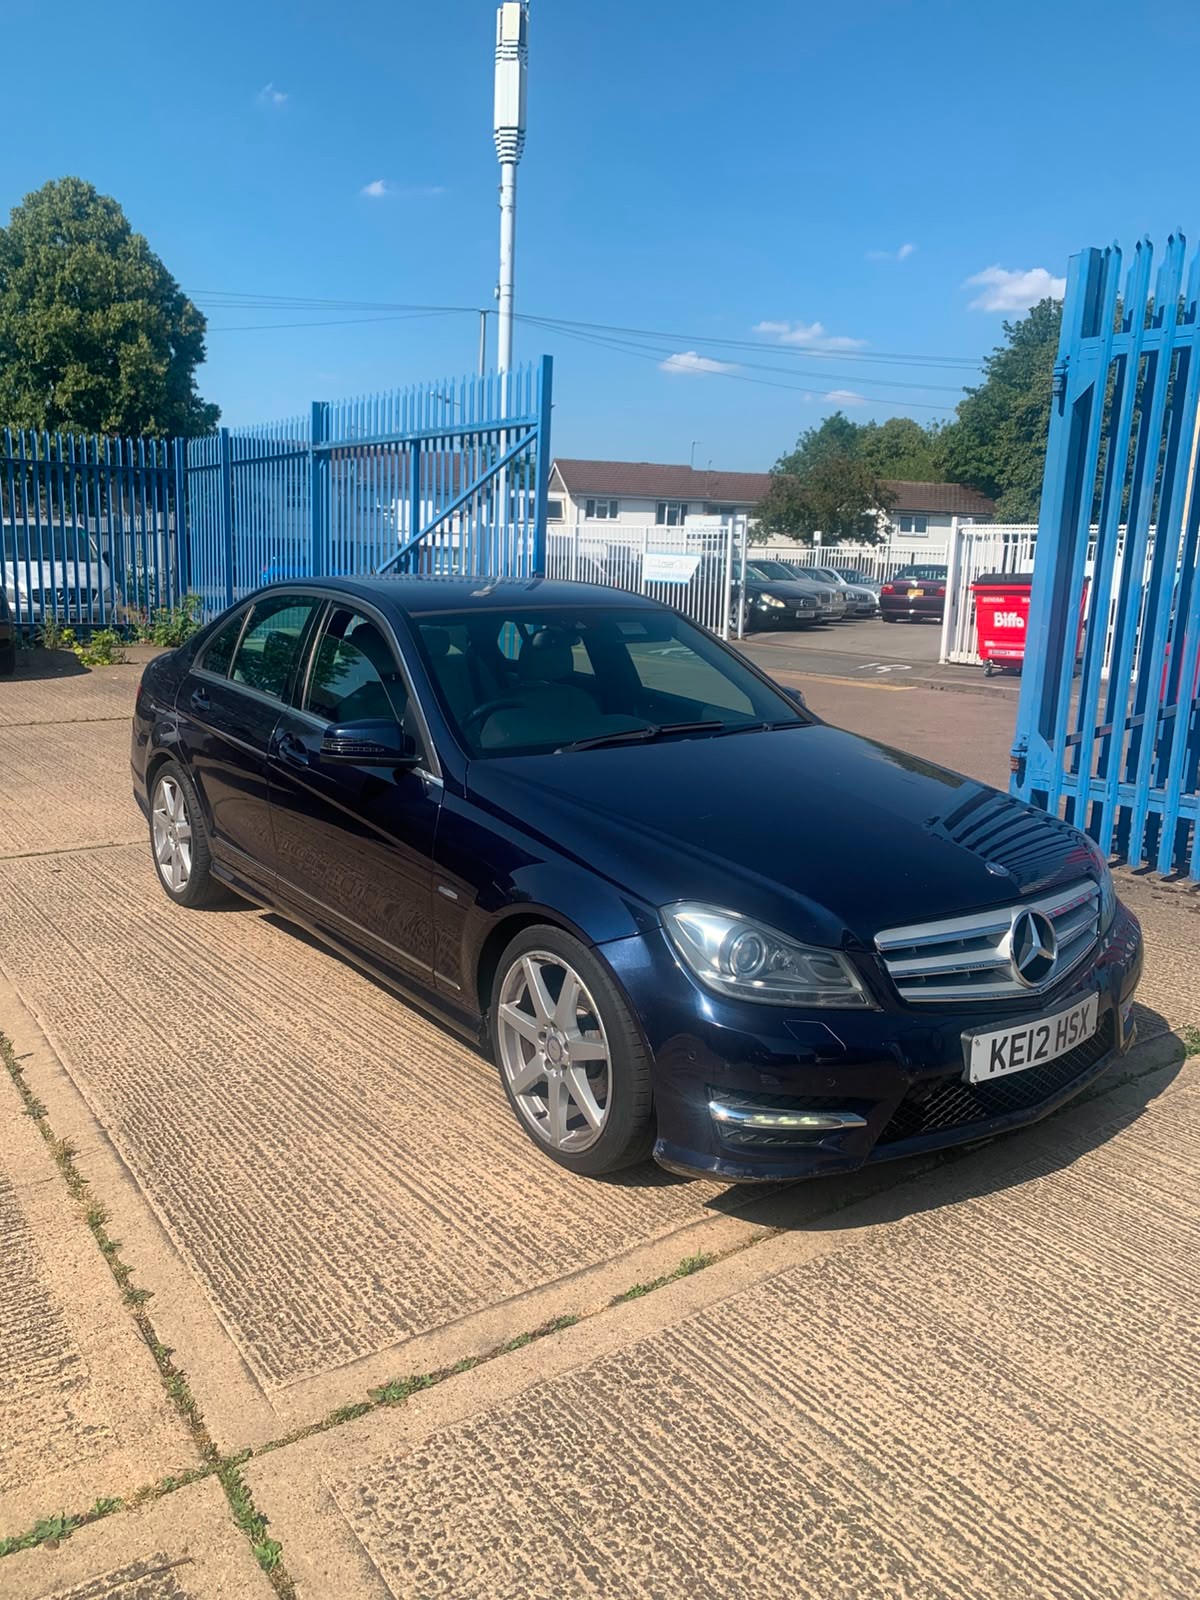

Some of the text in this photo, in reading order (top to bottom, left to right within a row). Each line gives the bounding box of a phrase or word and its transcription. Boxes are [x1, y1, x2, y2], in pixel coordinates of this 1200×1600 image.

[993, 611, 1025, 627] Biffa
[989, 1004, 1090, 1072] KE12 HSX
